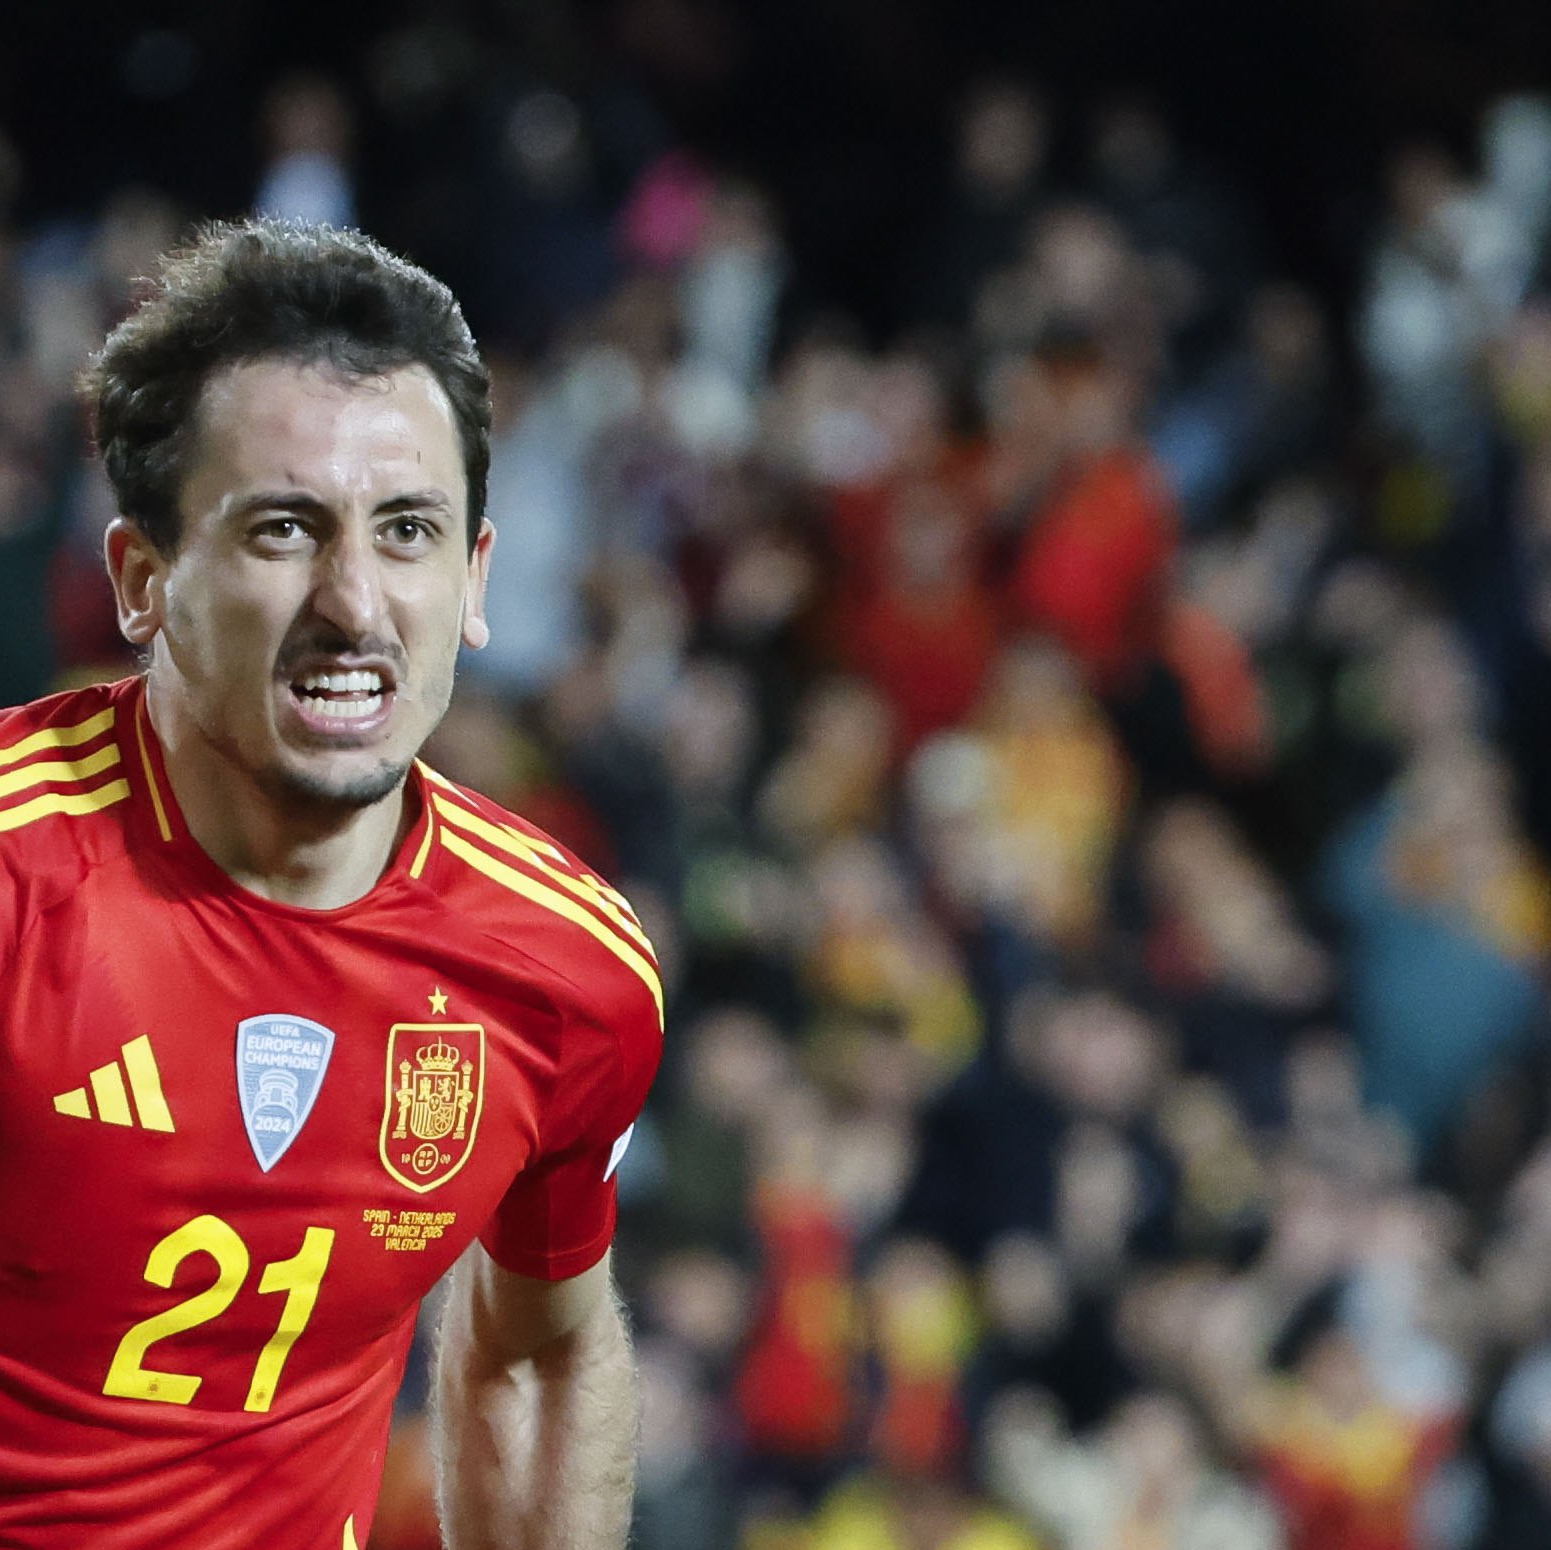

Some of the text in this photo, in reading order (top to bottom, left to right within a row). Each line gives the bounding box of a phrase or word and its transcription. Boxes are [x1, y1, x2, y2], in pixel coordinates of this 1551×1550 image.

[270, 1023, 300, 1038] UEFA
[246, 1034, 323, 1058] EUROPEAN
[244, 1050, 320, 1071] CHAMPIONS
[254, 1114, 292, 1134] 2024
[362, 1209, 391, 1223] SPAIN
[398, 1210, 457, 1226] NETHERLANDS
[385, 1224, 421, 1238] MARCH
[421, 1225, 446, 1239] 2025
[385, 1237, 427, 1251] VALENCIA
[102, 1214, 335, 1413] 21
